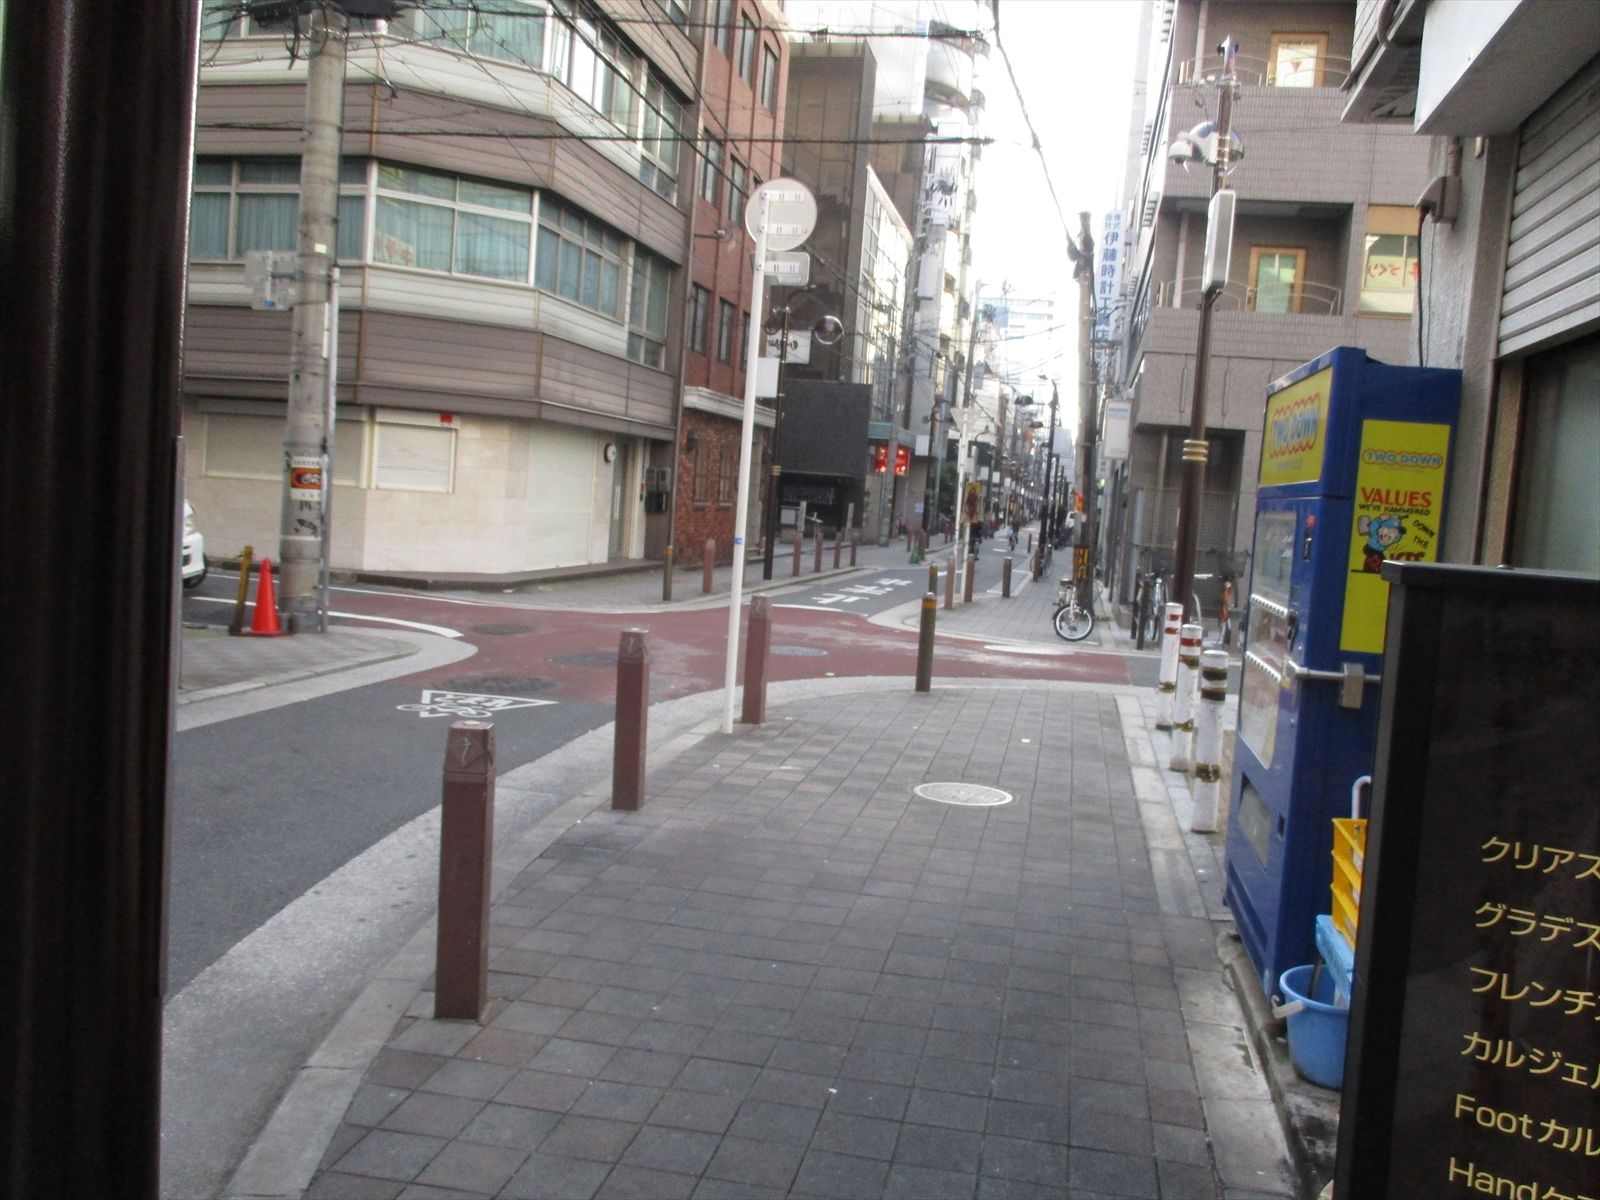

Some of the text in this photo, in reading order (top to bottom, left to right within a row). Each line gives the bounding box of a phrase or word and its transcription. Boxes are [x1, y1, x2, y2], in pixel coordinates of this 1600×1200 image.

[1367, 451, 1441, 466] TWO DOWN
[1360, 486, 1432, 507] VALUES
[1384, 505, 1431, 516] HAMMERED
[1412, 519, 1436, 538] DOWN
[1413, 536, 1429, 549] THE
[1474, 901, 1600, 949] グラデス
[1469, 966, 1600, 1021] フレンチ
